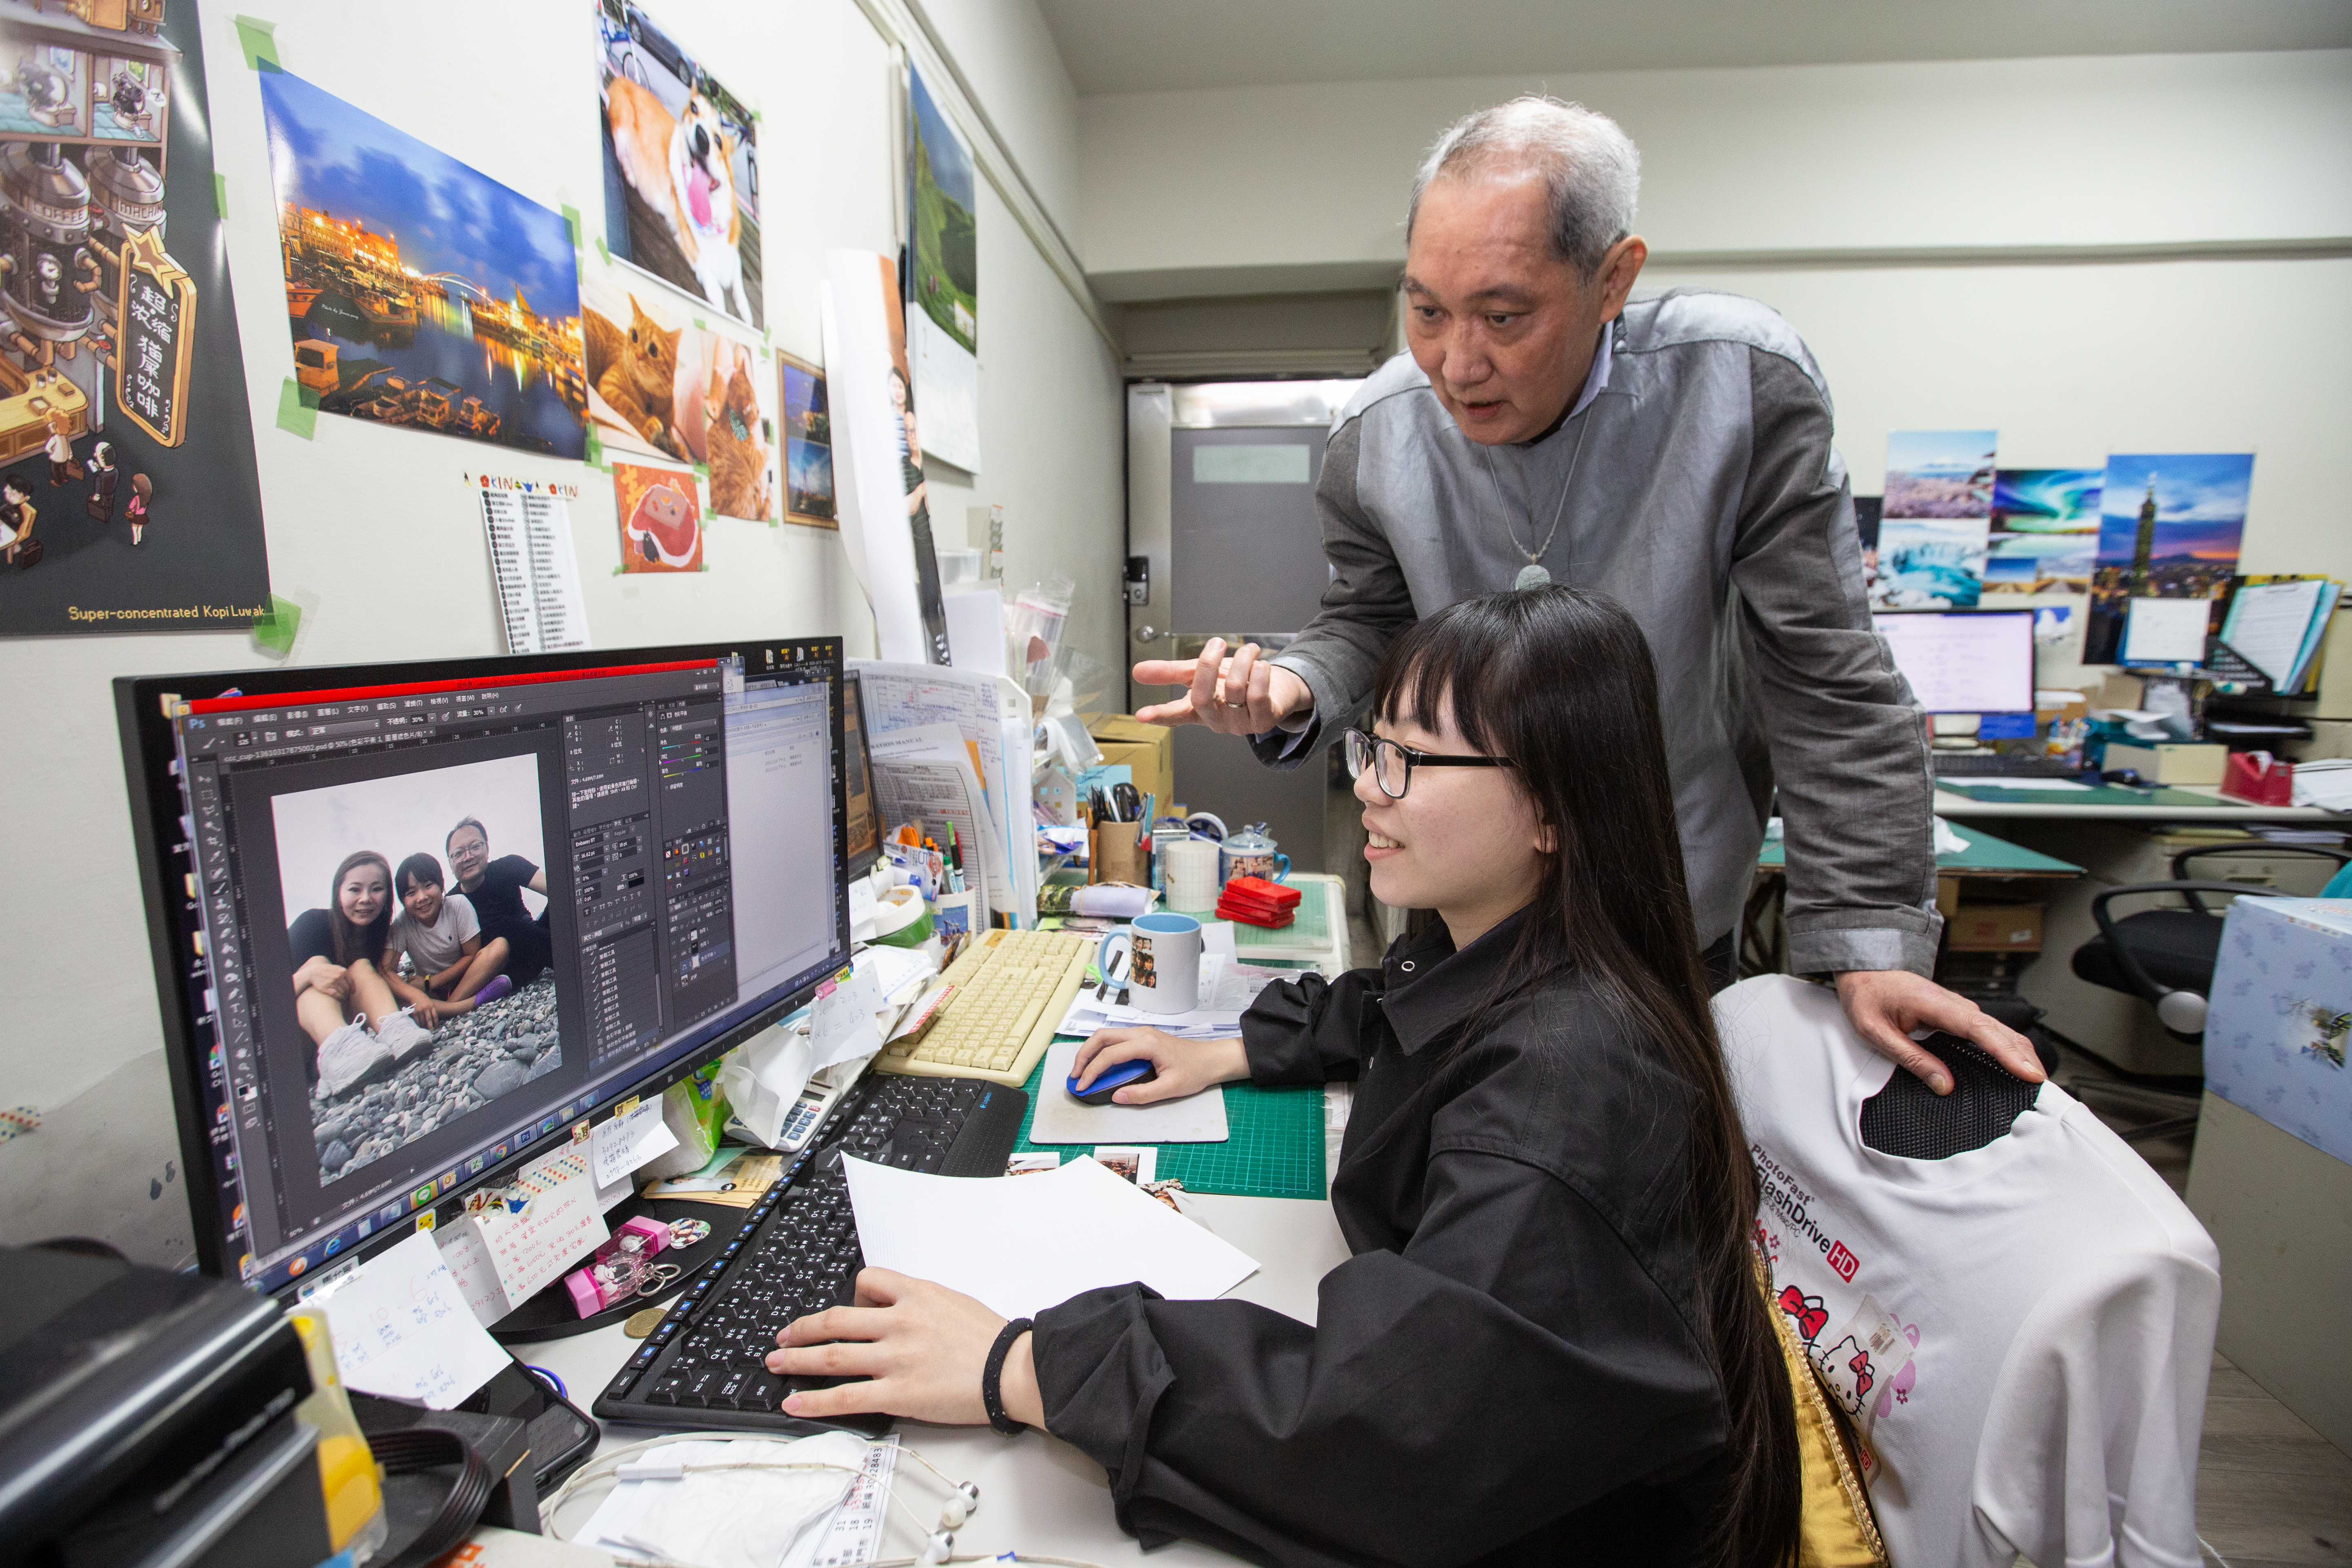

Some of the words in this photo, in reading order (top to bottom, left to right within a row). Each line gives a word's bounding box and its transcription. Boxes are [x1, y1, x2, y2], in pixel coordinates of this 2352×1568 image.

[68, 606, 199, 622] Super-concentrated
[203, 606, 229, 619] Kopi
[231, 605, 265, 617] Luwak
[189, 719, 205, 729] Ps
[575, 838, 590, 847] Embassy
[982, 1091, 992, 1106] Logitech
[1751, 1144, 1811, 1206] PhotoFast
[1829, 1244, 1856, 1277] HD
[619, 1376, 630, 1386] esc
[693, 1382, 704, 1392] tab
[721, 1381, 733, 1394] caps
[726, 1384, 739, 1395] lock
[757, 1385, 767, 1396] shift
[835, 1520, 846, 1532] 31
[849, 1519, 860, 1531] 18
[862, 1518, 873, 1530] 19
